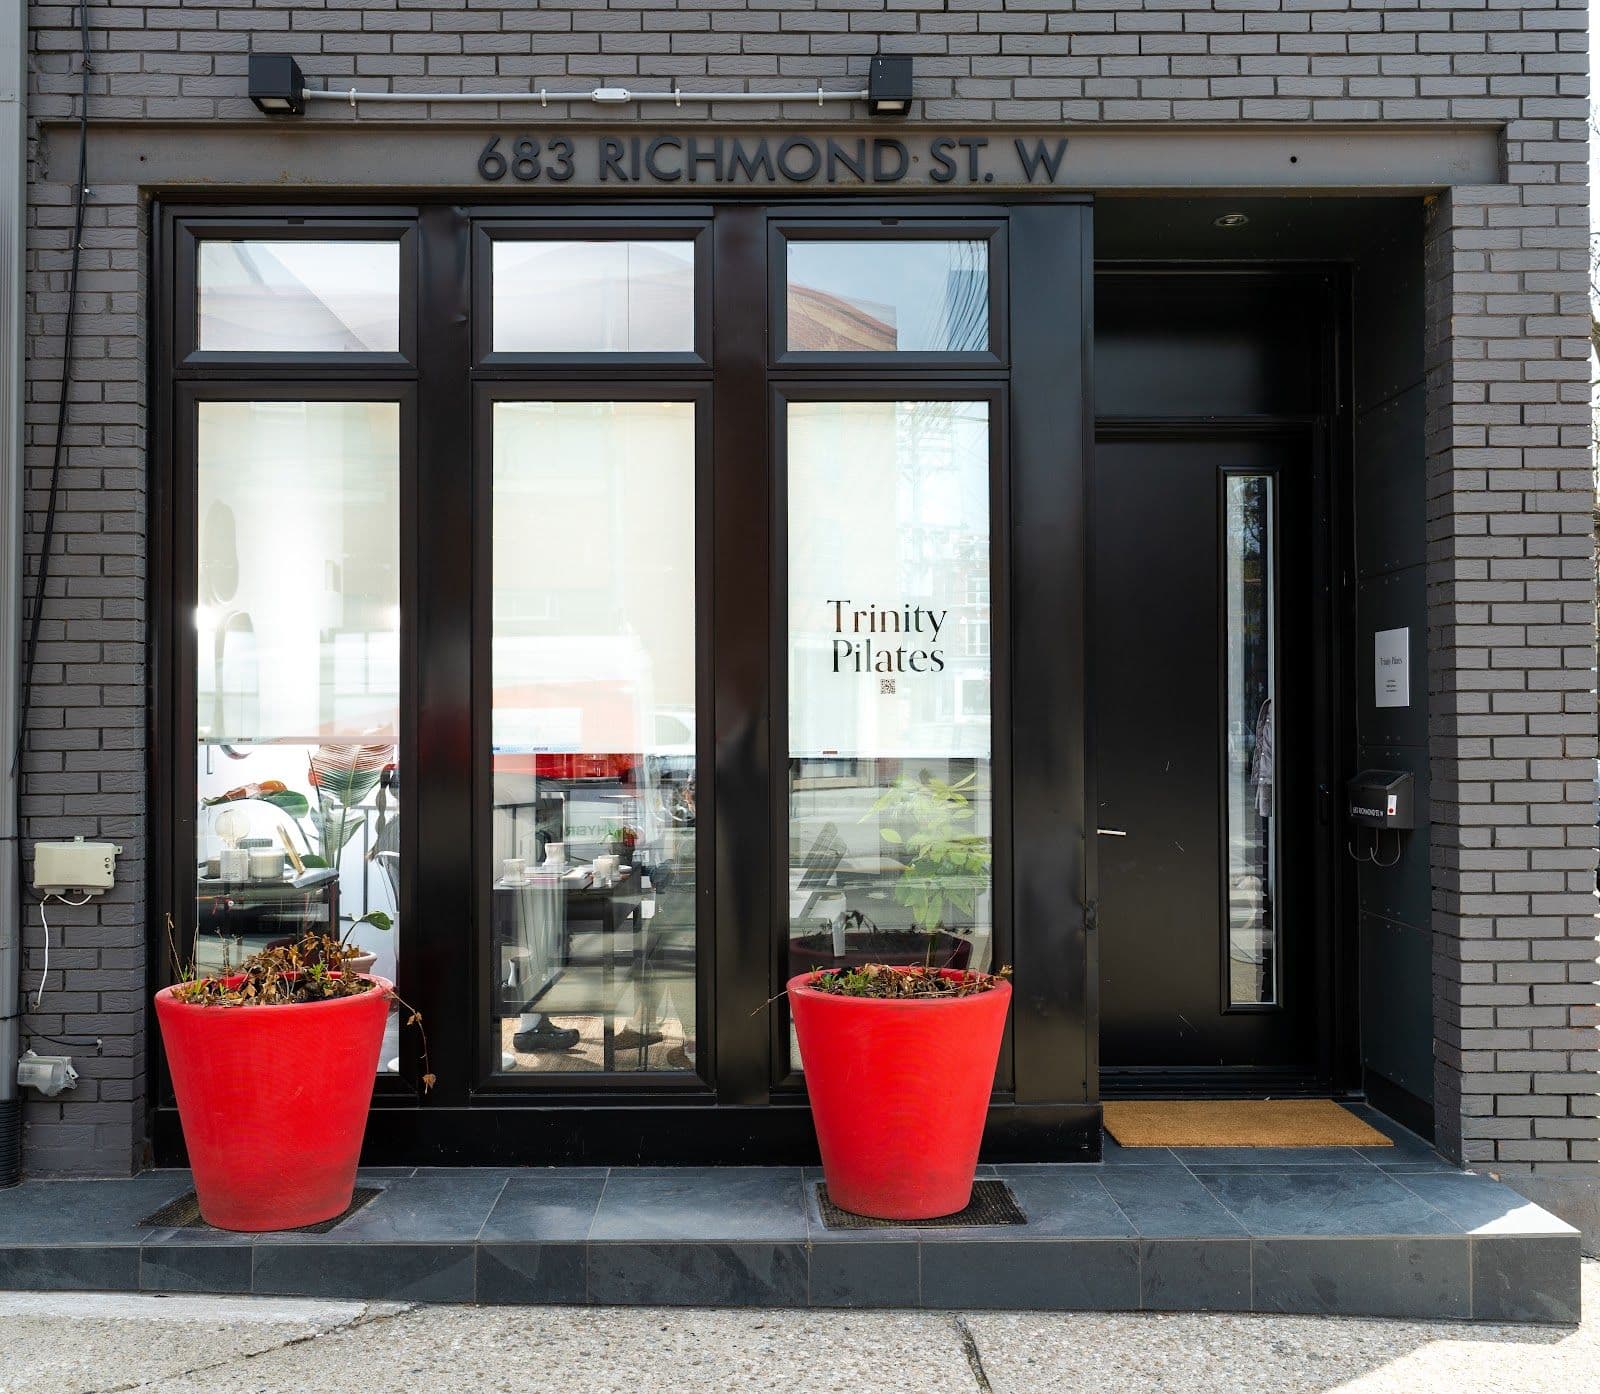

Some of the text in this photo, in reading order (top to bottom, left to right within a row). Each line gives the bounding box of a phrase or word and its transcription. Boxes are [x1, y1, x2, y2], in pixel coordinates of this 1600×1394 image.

[477, 135, 1069, 183] 683 RICHMOND ST. W
[826, 599, 948, 642] Trinity
[832, 638, 945, 673] Pilates
